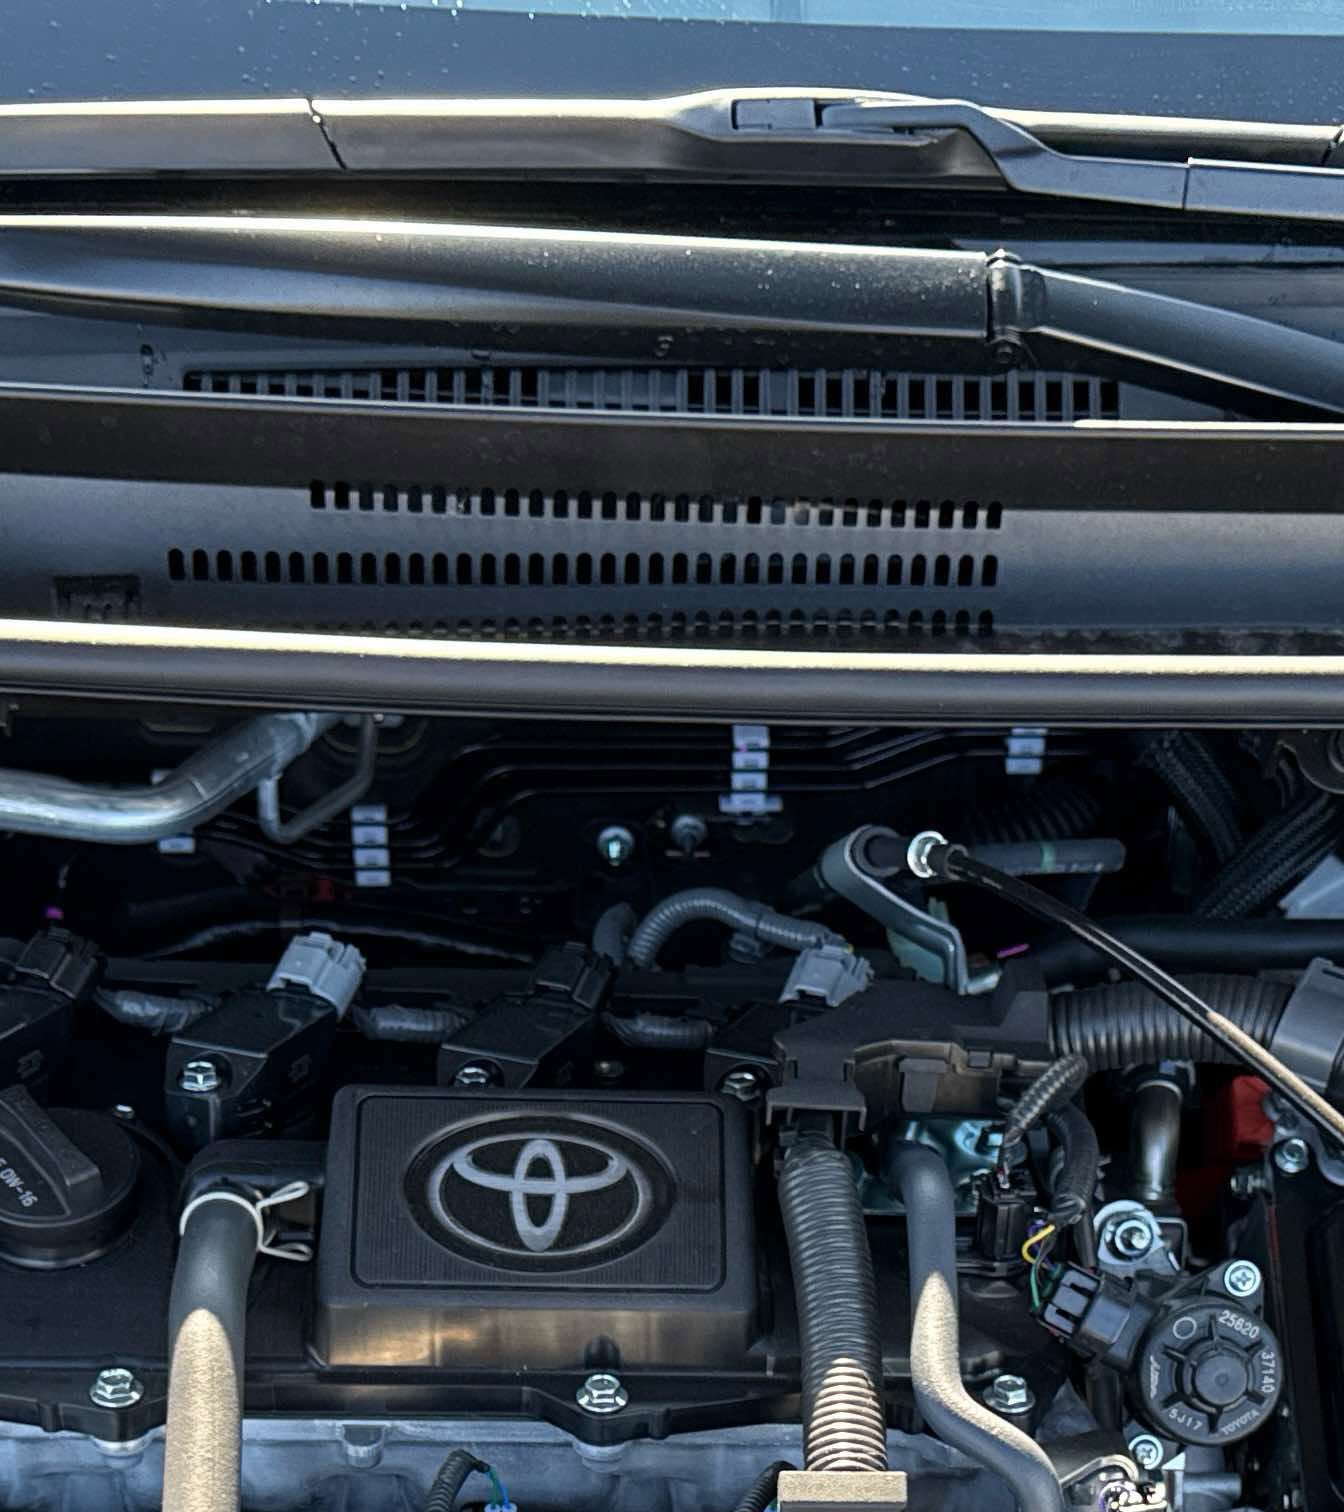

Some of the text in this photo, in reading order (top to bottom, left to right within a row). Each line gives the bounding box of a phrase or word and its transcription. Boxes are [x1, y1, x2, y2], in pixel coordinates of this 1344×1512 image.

[0, 1168, 38, 1207] 0W-16
[1261, 1352, 1276, 1393] 37140
[1169, 1408, 1203, 1431] 5J17
[1221, 1409, 1260, 1435] TOYOTA
